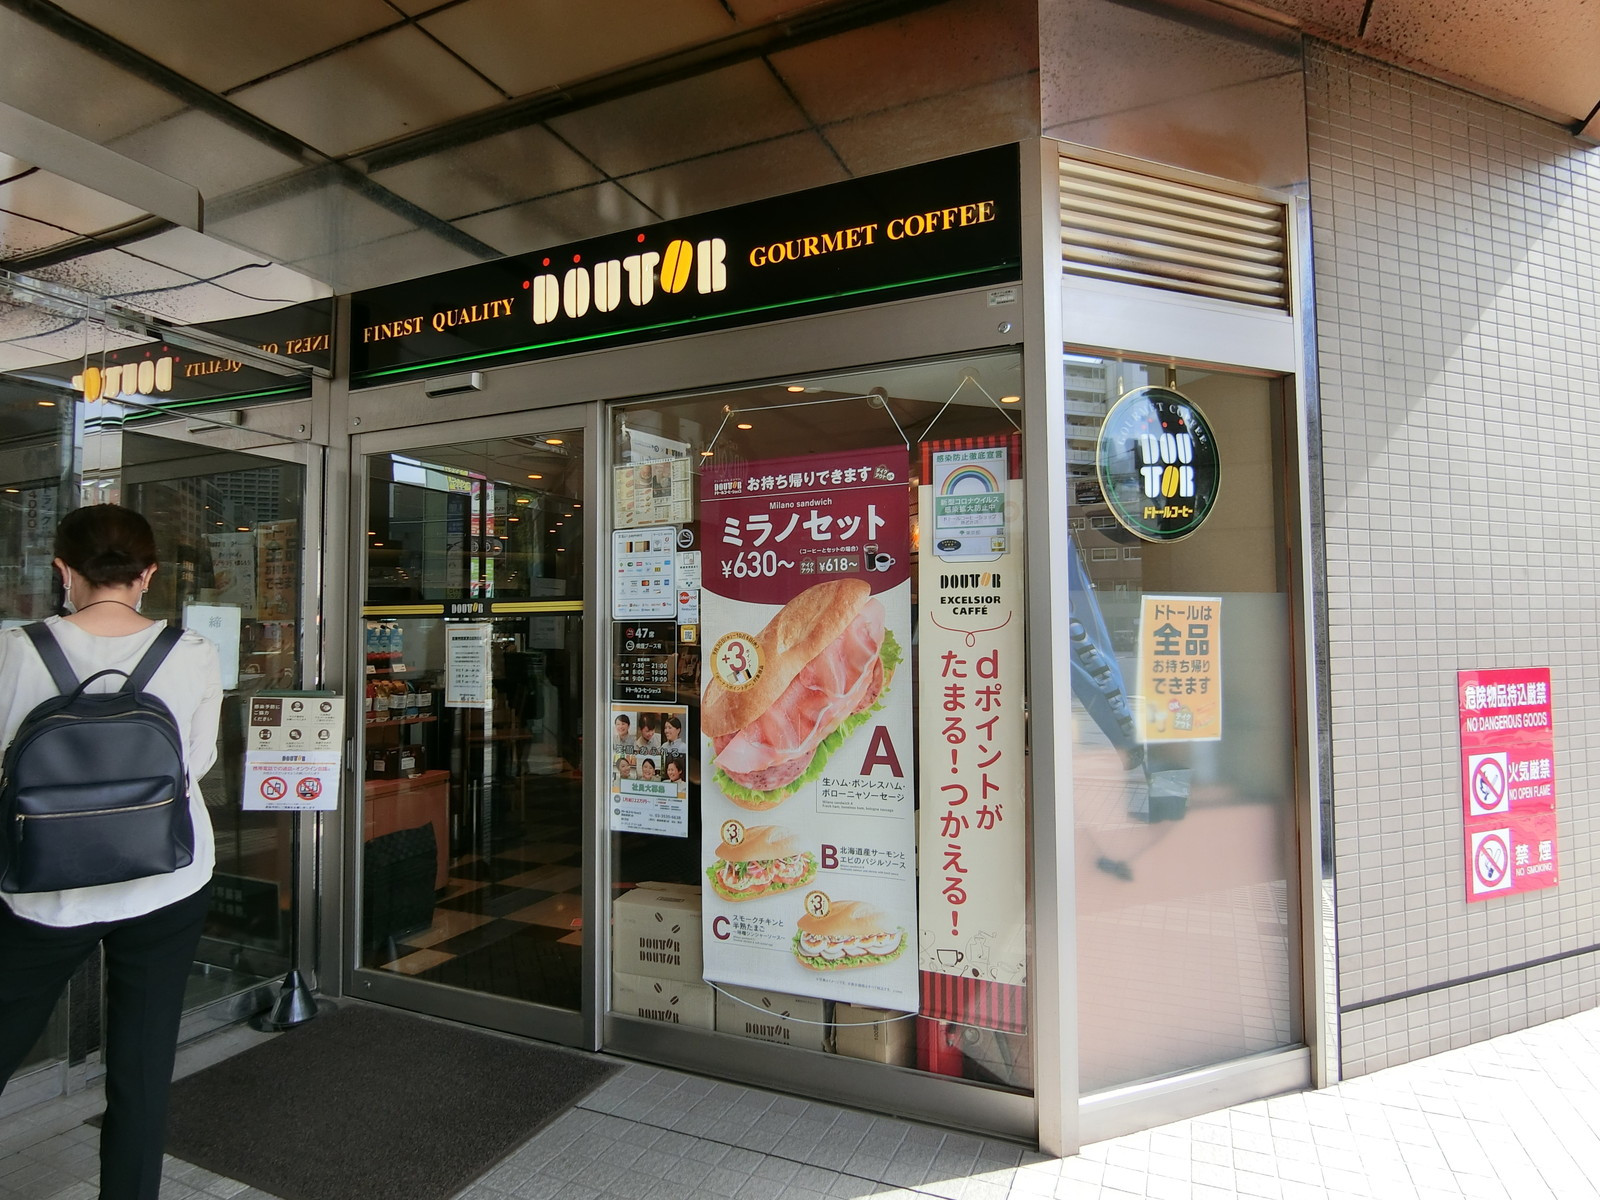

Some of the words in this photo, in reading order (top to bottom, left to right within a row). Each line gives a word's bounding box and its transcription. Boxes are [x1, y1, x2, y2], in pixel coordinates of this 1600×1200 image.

[749, 224, 879, 268] GOURMET
[887, 200, 996, 240] COFFEE
[532, 237, 727, 325] DOUTOR
[363, 316, 424, 343] FINEST
[432, 298, 515, 332] QUALITY
[1141, 432, 1194, 465] DOU
[747, 466, 872, 492] お持ち帰りできます
[1140, 465, 1194, 498] TOR
[769, 501, 795, 510] Milano
[796, 498, 833, 508] sandwich
[1143, 505, 1194, 520] ドトールコーヒー
[722, 504, 886, 547] ミラノセット
[940, 572, 1001, 589] DOUTOR
[451, 602, 484, 614] DOUTOR
[940, 596, 1001, 605] EXCELSIOR
[952, 605, 988, 615] CAFFÉ
[1154, 604, 1213, 621] ドトールは
[1153, 623, 1210, 656] 全品
[721, 641, 747, 673] +3
[1152, 659, 1210, 673] お持ち帰り
[1152, 676, 1211, 695] できます
[1465, 682, 1547, 710] 危険物品持込厳禁
[1466, 717, 1478, 732] NO
[1479, 713, 1523, 731] DANGEROUS
[1523, 712, 1548, 728] GOODS
[975, 649, 1003, 830] dポイントが
[859, 725, 905, 778] A
[1508, 758, 1551, 783] 火気厳禁
[822, 788, 905, 802] ボローニャソーセージ
[1508, 788, 1518, 801] NO
[1518, 786, 1533, 799] OPEN
[1534, 784, 1551, 797] FLAME
[821, 844, 839, 870] B
[840, 846, 905, 860] 北海道産サーモンと
[840, 856, 907, 869] エビのバジルソース
[1515, 867, 1525, 877] NO
[1526, 863, 1552, 875] SMOKING
[713, 915, 731, 941] C
[733, 914, 784, 928] スモークチキンと
[639, 937, 680, 952] DOUTOR
[639, 951, 681, 966] DOUTOR
[638, 1008, 679, 1024] DOUTOR
[745, 1022, 790, 1040] DOUTOR
